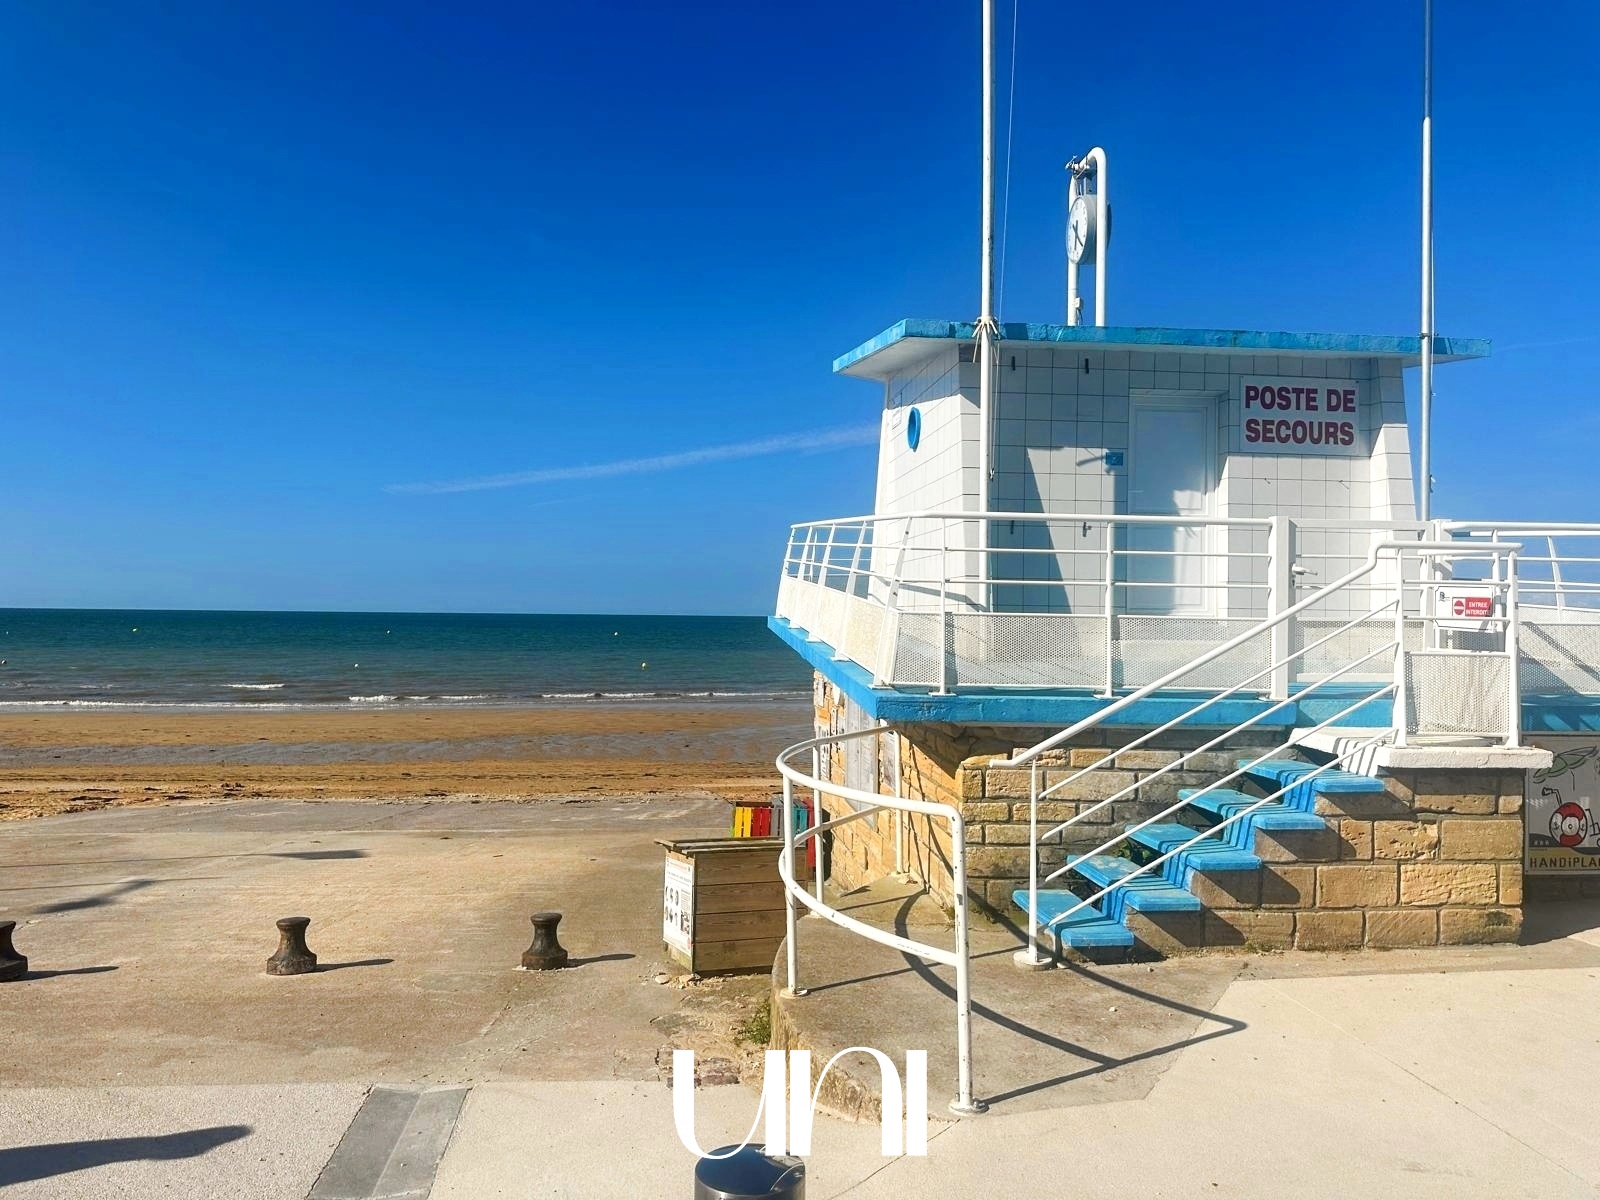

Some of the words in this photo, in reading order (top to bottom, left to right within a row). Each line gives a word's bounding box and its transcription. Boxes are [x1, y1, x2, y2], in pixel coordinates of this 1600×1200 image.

[1245, 385, 1318, 411] POSTE
[1326, 388, 1356, 412] DE
[1245, 418, 1355, 446] SECOURS
[1530, 857, 1600, 868] HANDiPLA
